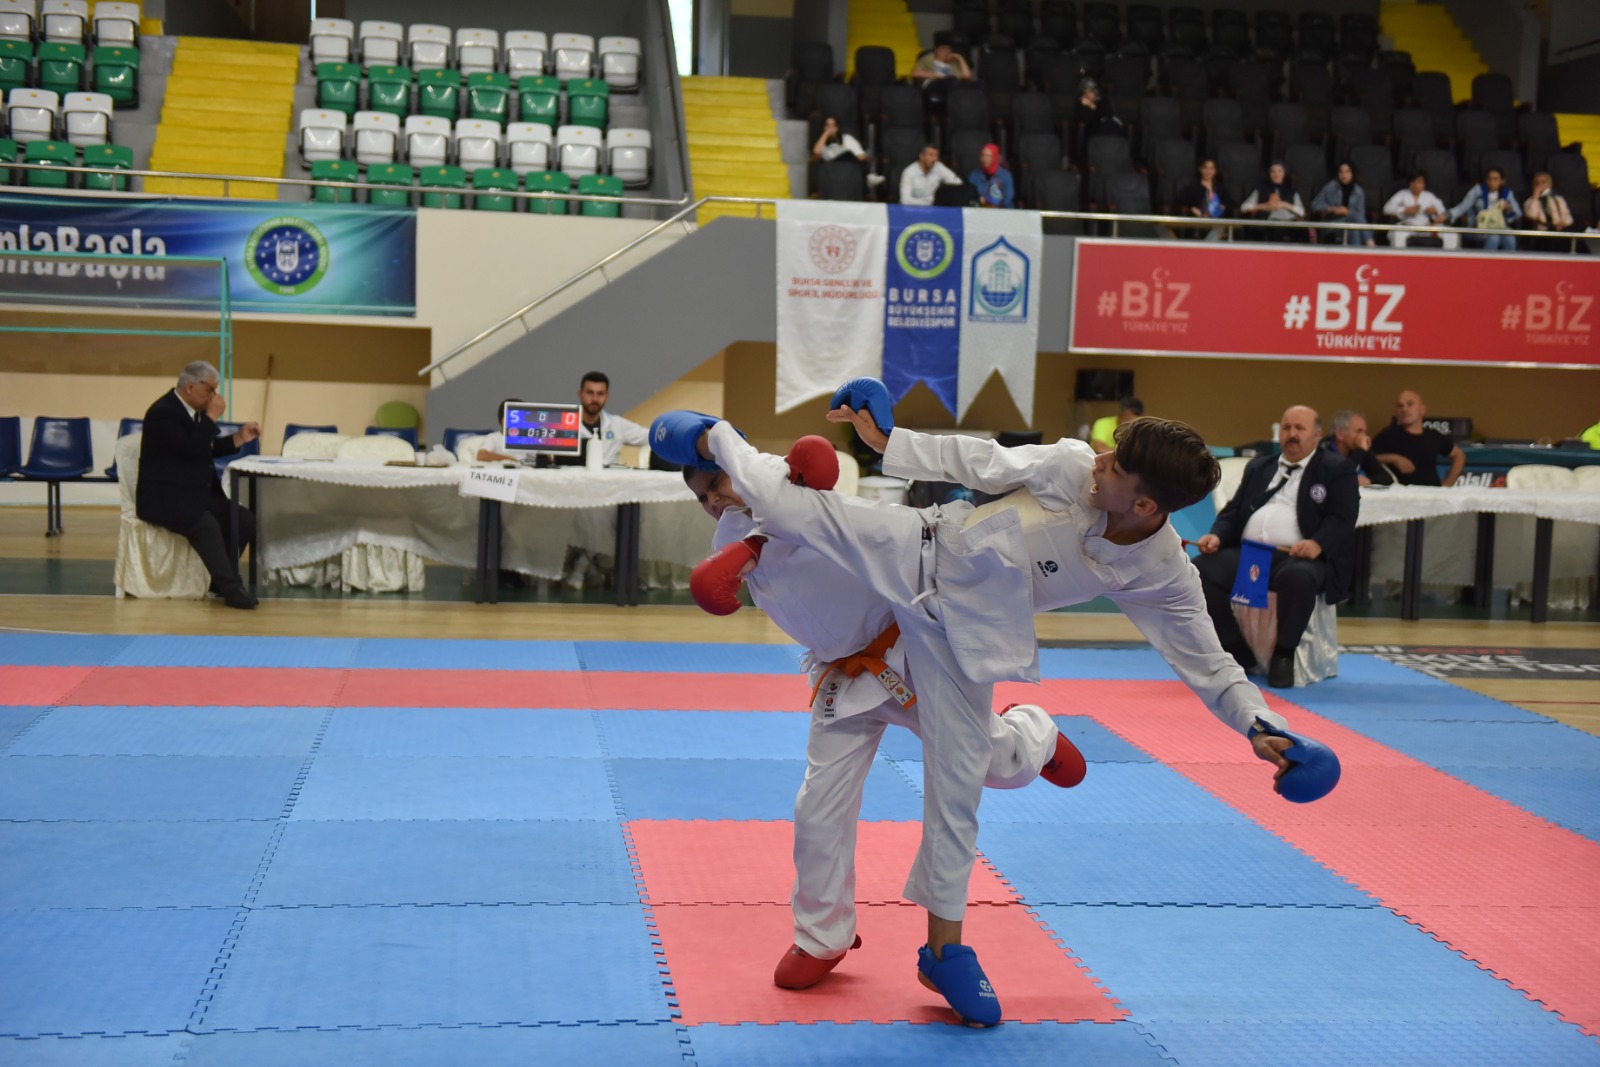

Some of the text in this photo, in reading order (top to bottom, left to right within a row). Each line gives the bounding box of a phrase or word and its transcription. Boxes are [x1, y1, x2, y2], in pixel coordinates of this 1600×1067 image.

[888, 288, 957, 303] BURSA
[1316, 332, 1401, 350] TÜRKİYE'YİZ
[565, 412, 576, 425] 0
[527, 427, 556, 438] 0:32
[507, 478, 513, 486] 2
